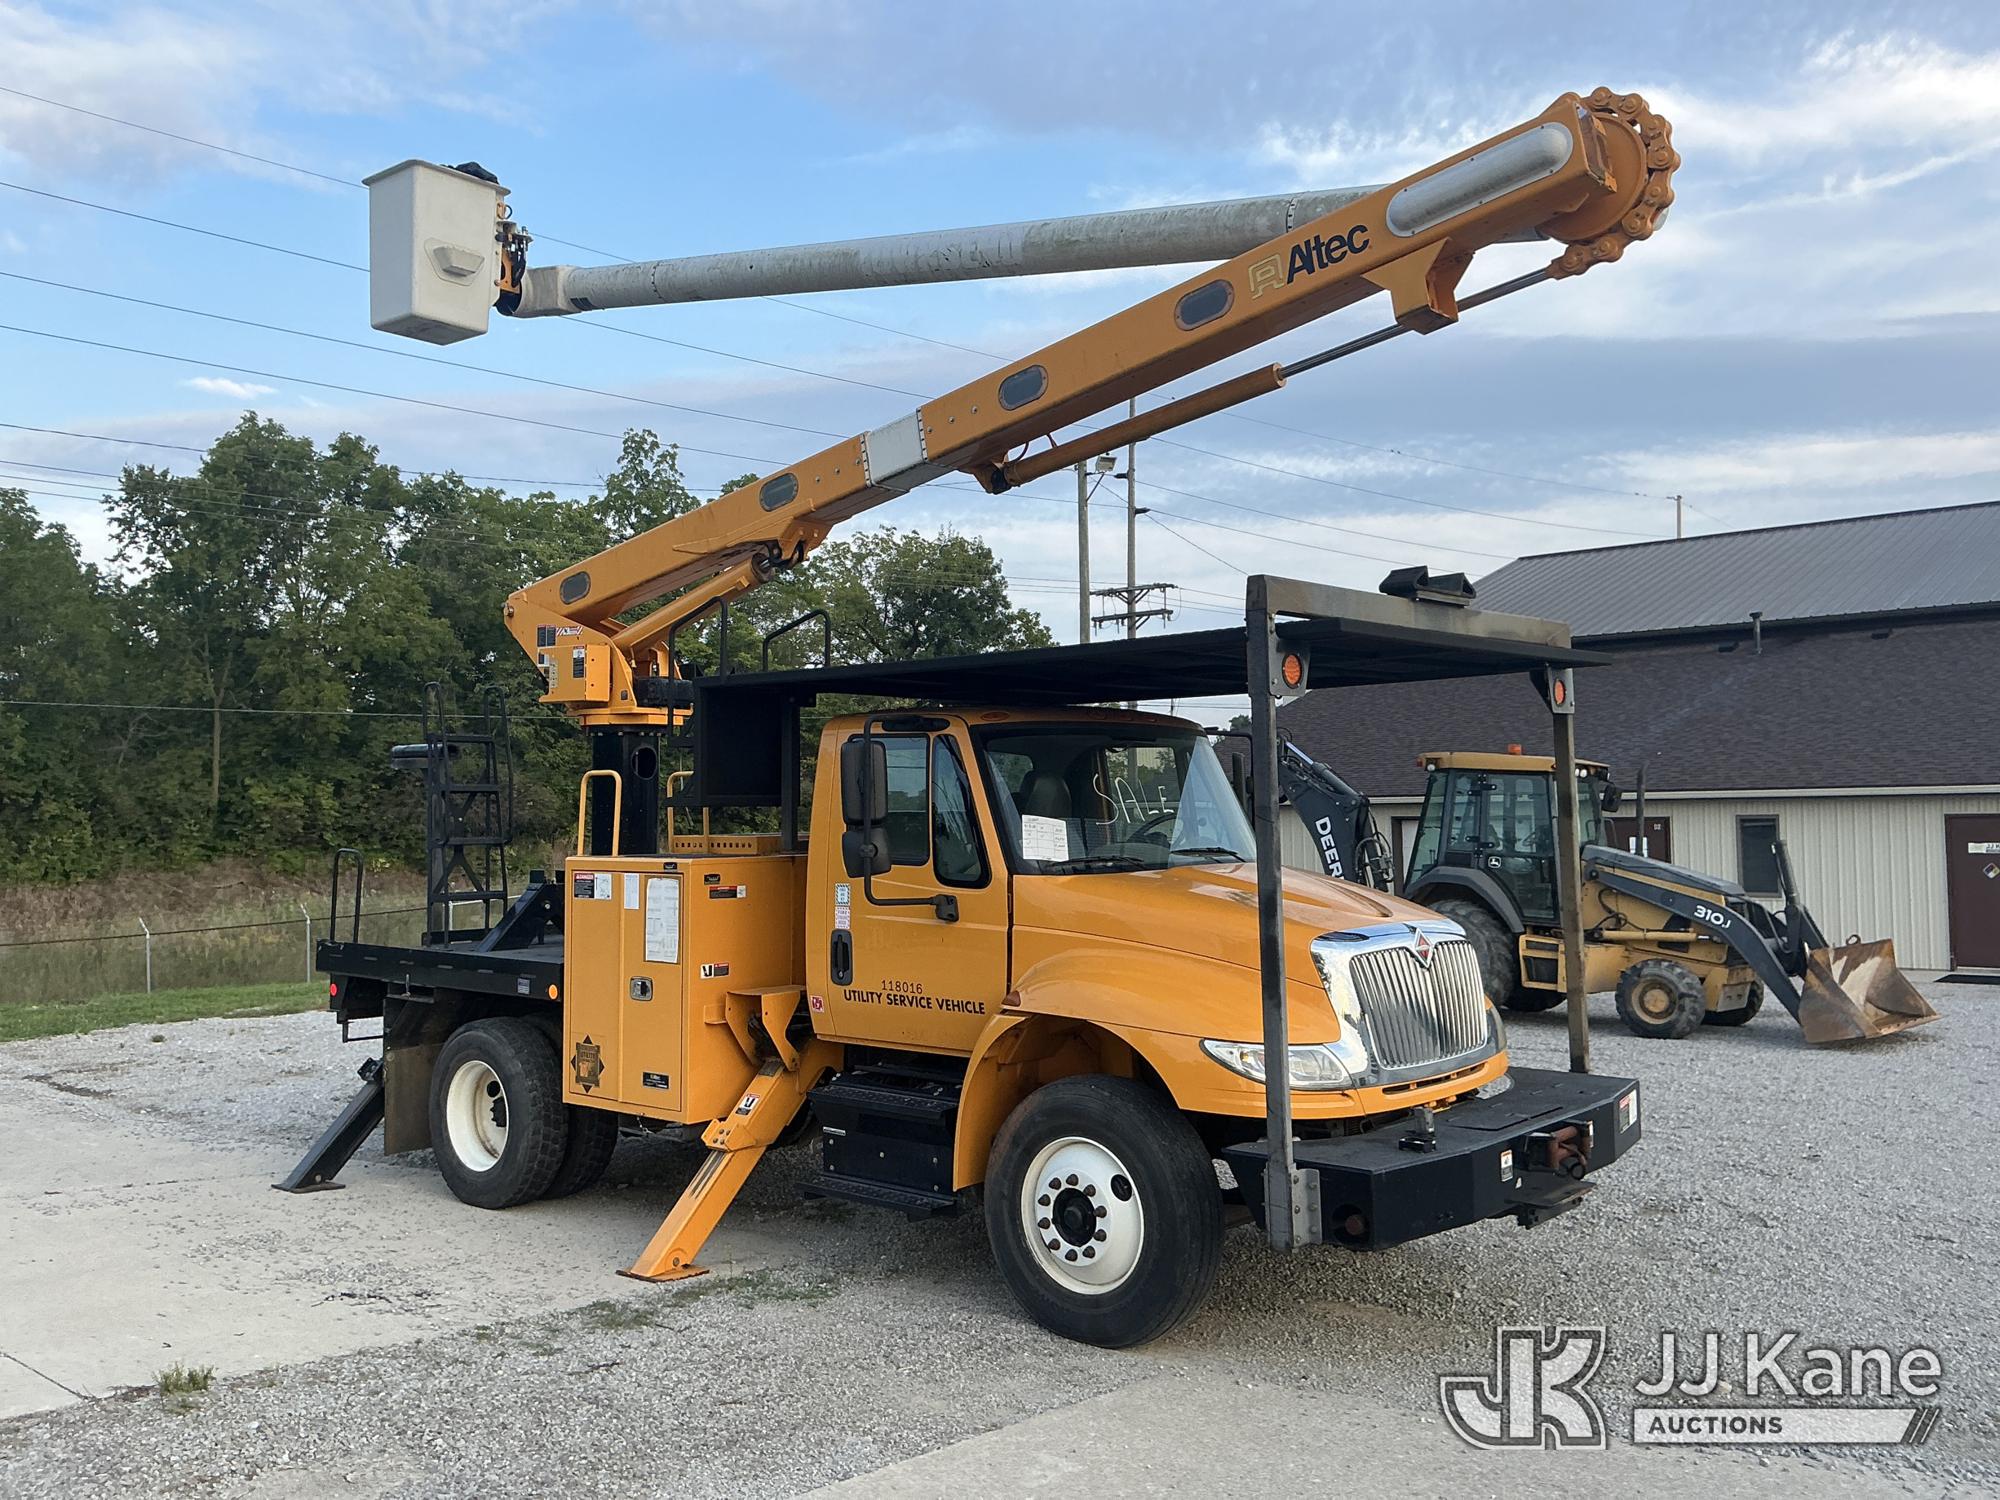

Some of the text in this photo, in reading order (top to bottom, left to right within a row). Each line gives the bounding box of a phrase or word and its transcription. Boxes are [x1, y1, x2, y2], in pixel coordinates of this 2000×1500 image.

[1286, 224, 1370, 285] Altec
[1093, 773, 1175, 826] SALE
[1693, 904, 1732, 929] 310J
[880, 979, 923, 995] 118016
[843, 989, 986, 1015] UTILITY SERVICE VEHICLE
